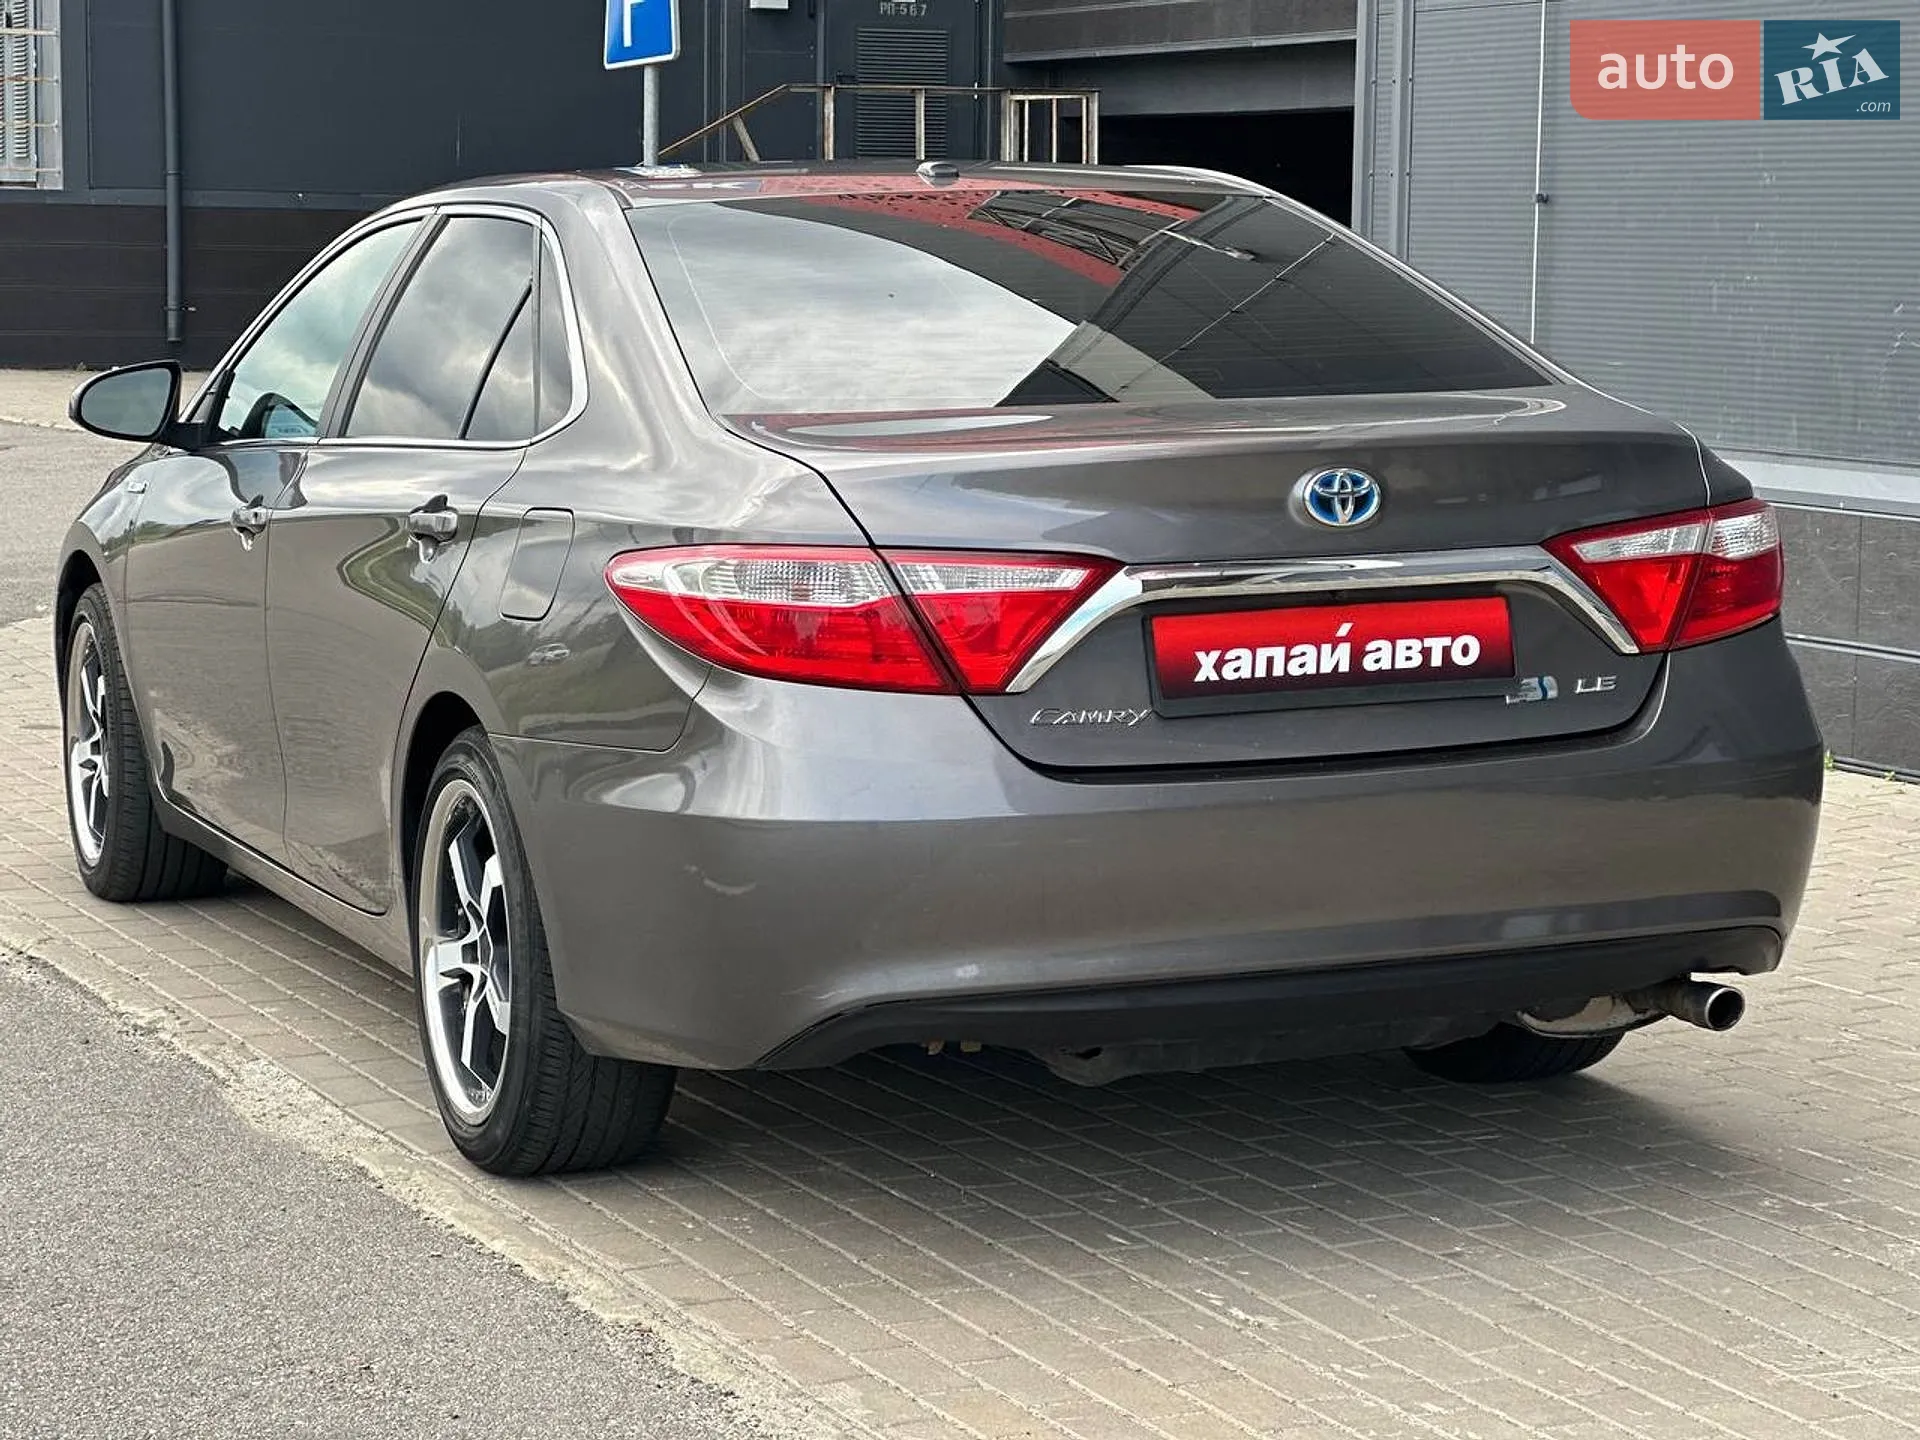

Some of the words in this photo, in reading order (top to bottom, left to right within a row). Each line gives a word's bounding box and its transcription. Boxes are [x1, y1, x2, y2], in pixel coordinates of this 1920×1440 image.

[1362, 634, 1481, 672] авто
[1575, 675, 1617, 694] LE
[1030, 708, 1152, 726] CAMRY
